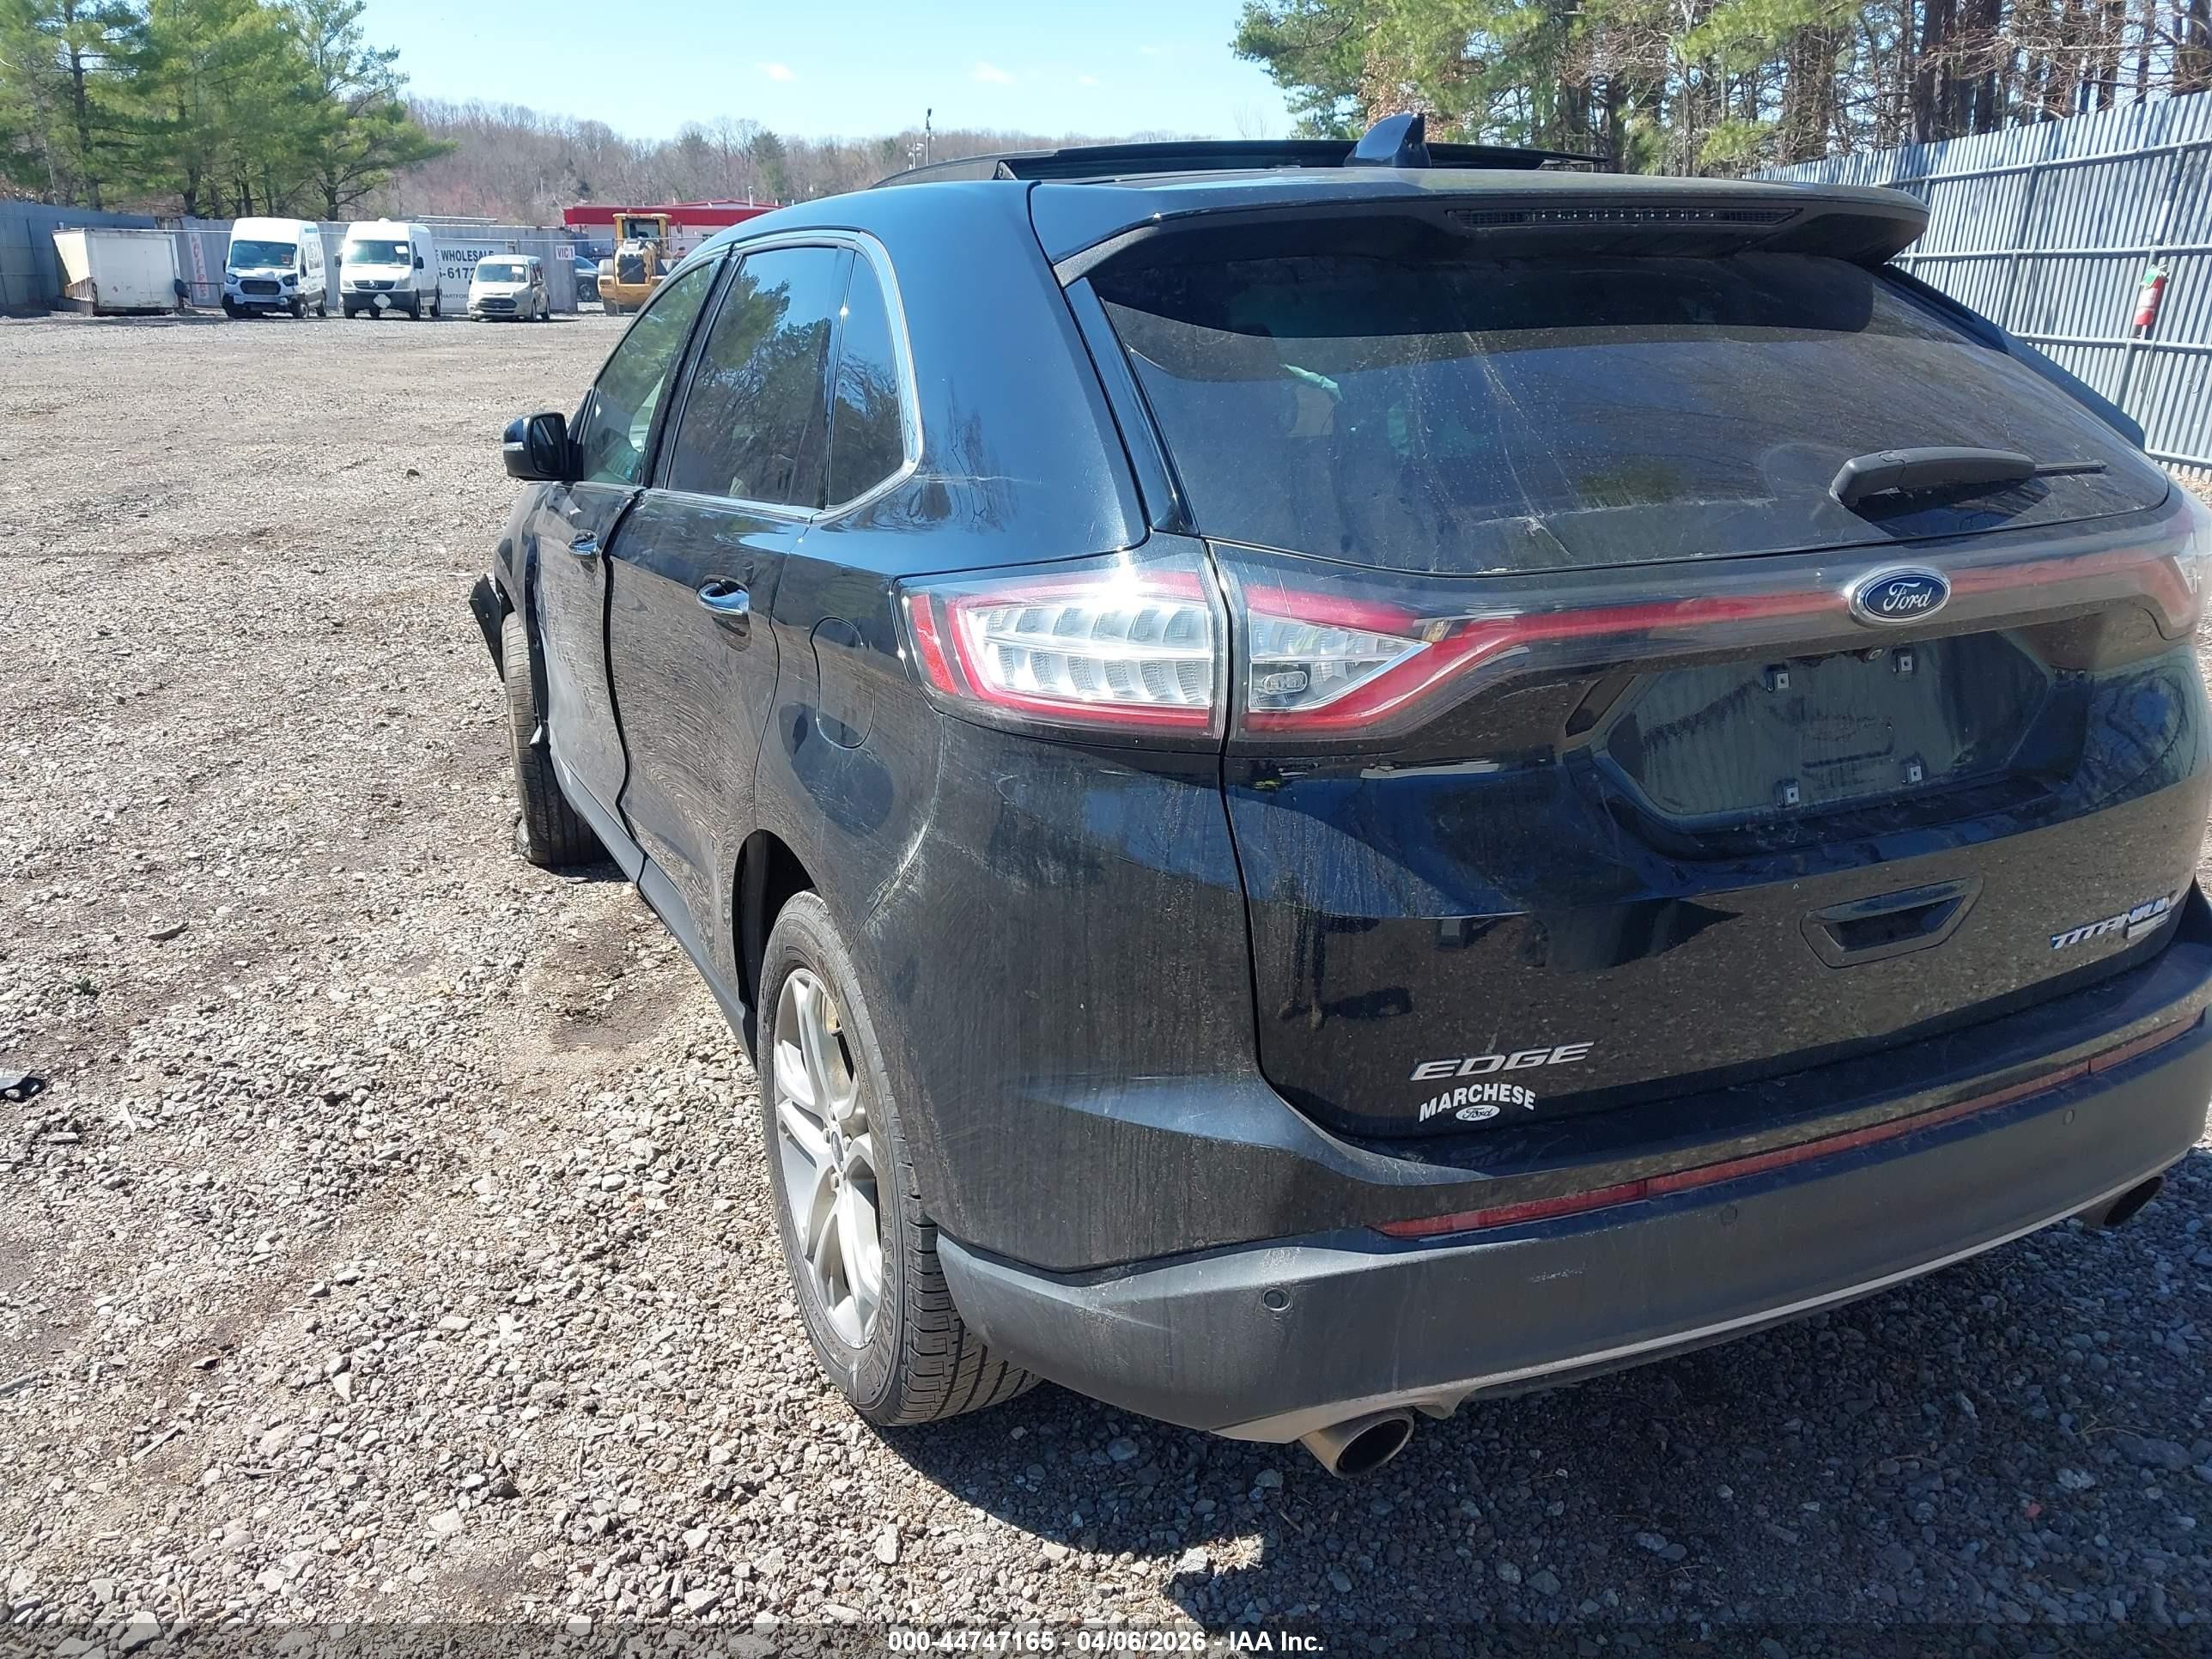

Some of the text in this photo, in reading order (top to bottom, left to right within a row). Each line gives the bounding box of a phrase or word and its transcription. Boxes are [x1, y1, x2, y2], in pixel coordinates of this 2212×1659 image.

[556, 247, 568, 258] VIC
[1883, 581, 1933, 611] Ford
[1409, 1041, 1595, 1081] EDGE
[1419, 1083, 1536, 1123] MARCHESE
[1460, 1106, 1496, 1120] Ford
